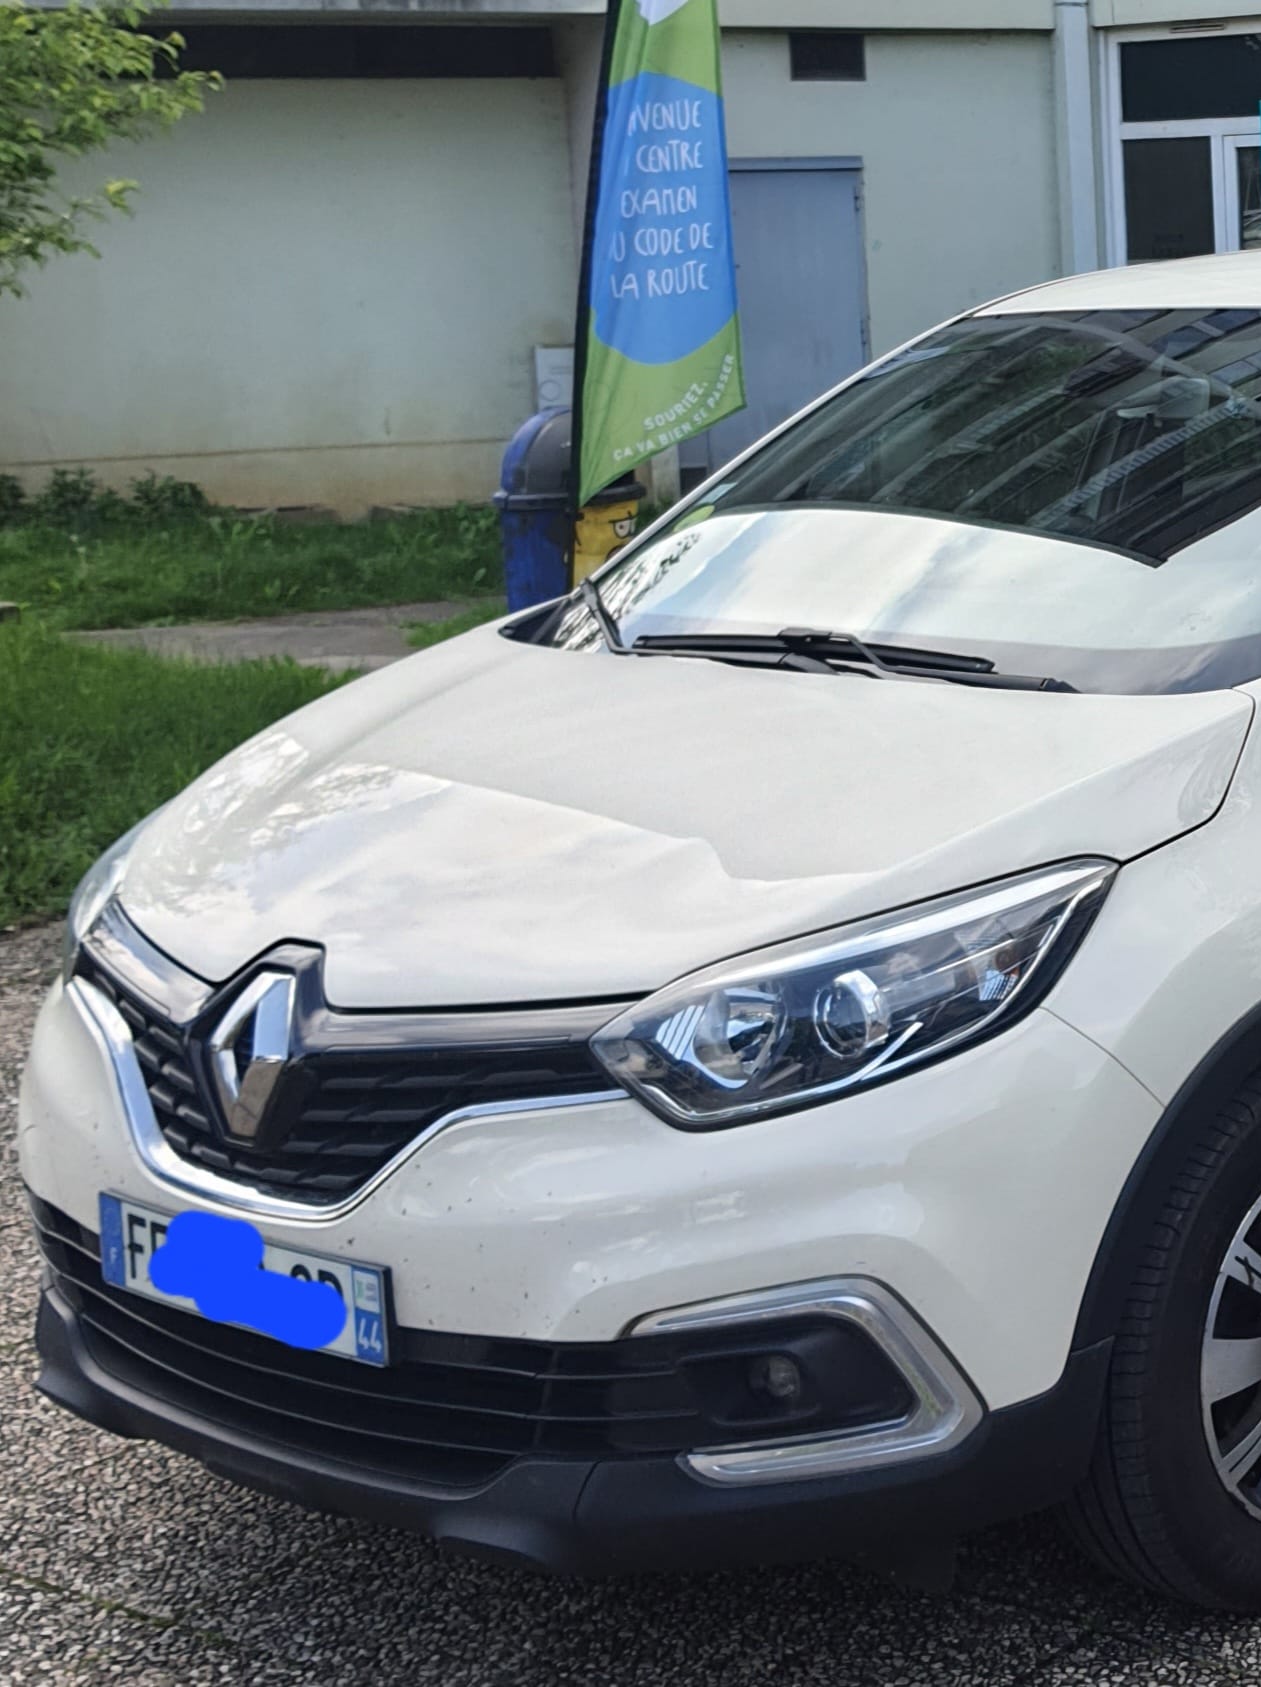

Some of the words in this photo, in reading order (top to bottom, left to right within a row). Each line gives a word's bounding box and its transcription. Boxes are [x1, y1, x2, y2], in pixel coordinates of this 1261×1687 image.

[636, 140, 703, 173] CENTRE
[634, 226, 684, 256] CODE
[689, 222, 714, 250] DE
[610, 273, 640, 299] LA
[647, 260, 709, 298] ROUTE
[636, 438, 656, 454] VA
[657, 421, 693, 446] BIEN
[706, 353, 735, 409] PASSER
[358, 1317, 382, 1353] 44
